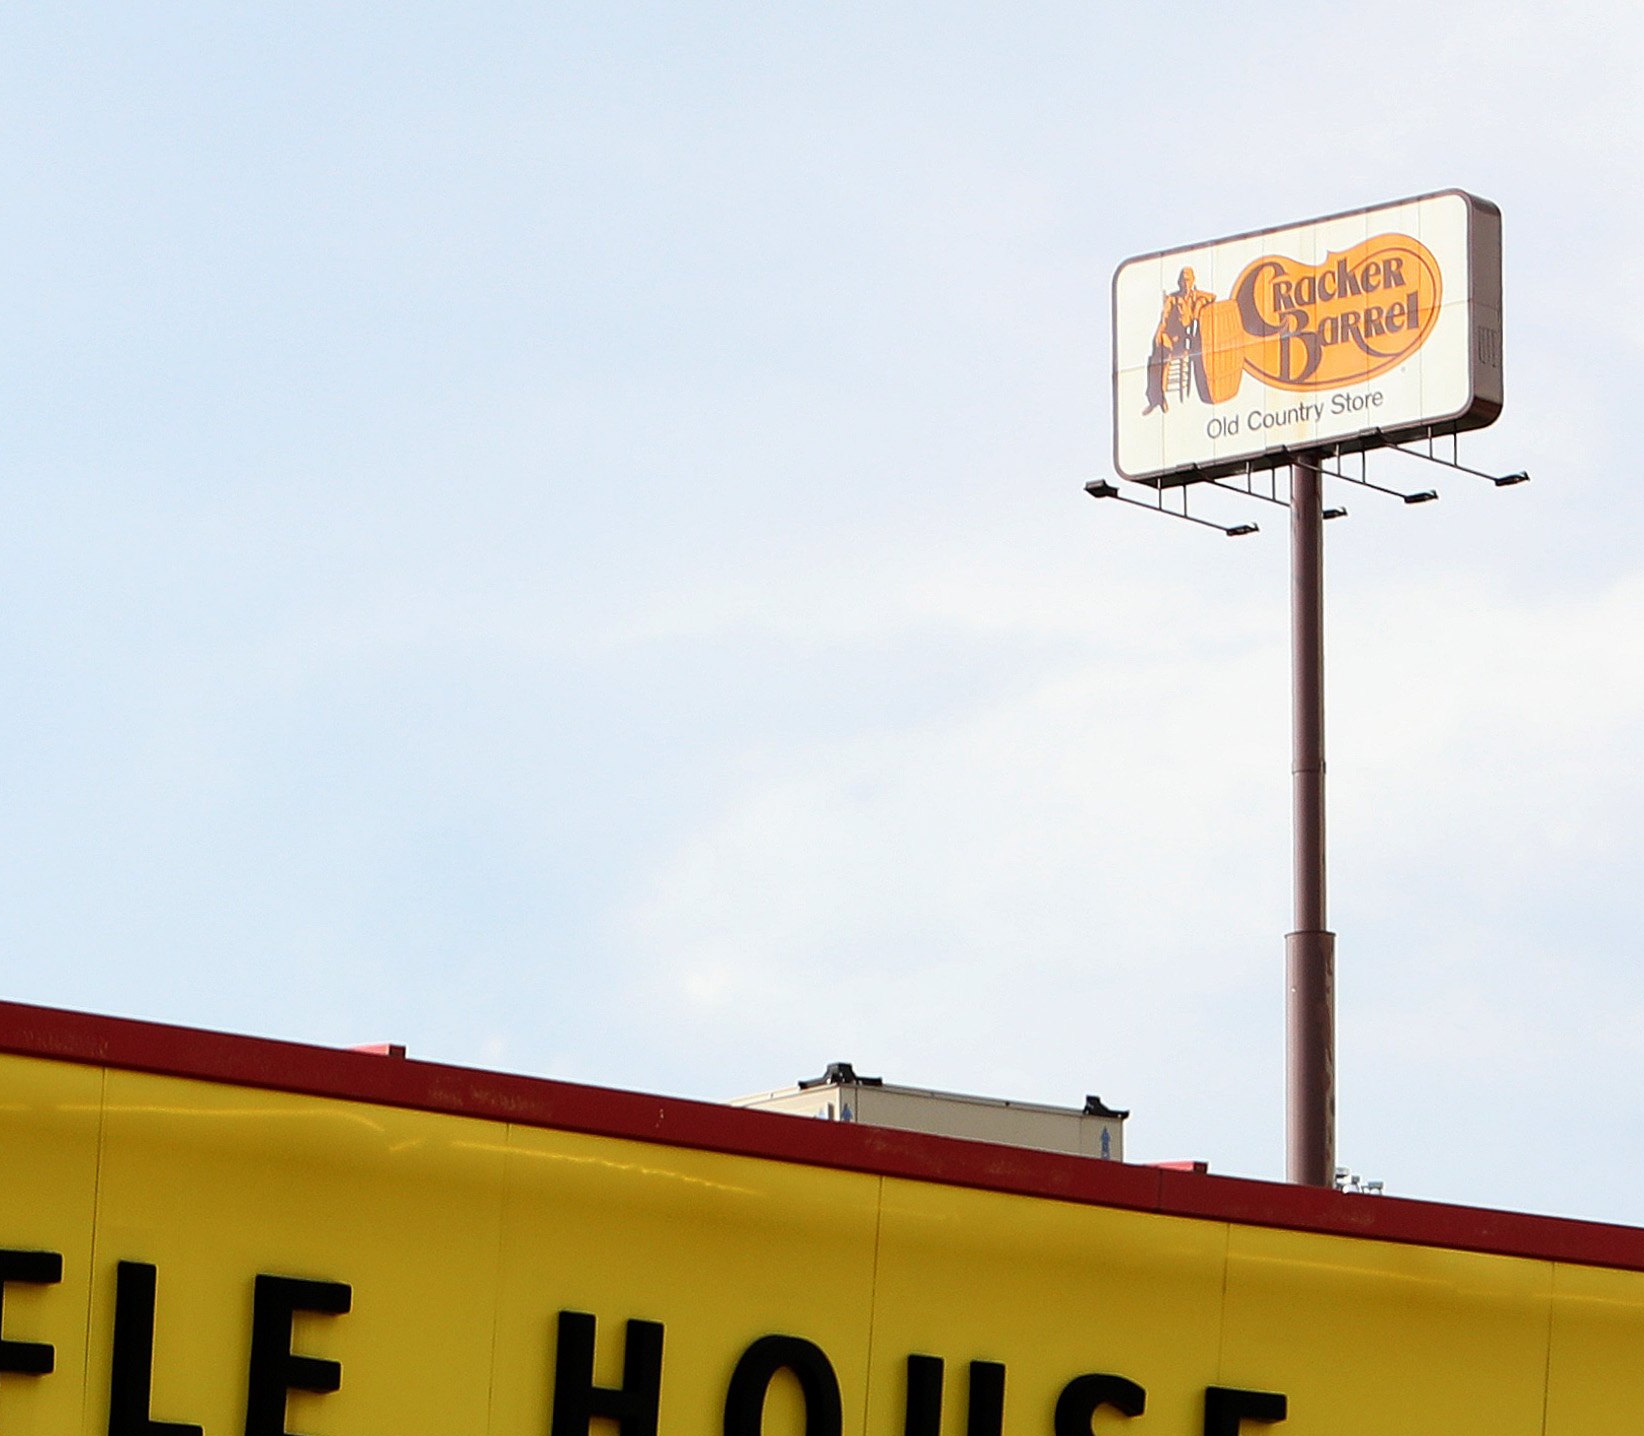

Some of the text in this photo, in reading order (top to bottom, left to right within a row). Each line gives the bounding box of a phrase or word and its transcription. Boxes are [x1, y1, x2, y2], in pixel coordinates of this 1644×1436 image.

[1236, 256, 1407, 338] Cracker
[1279, 292, 1420, 385] Barrel
[1207, 389, 1384, 440] Old Country Store
